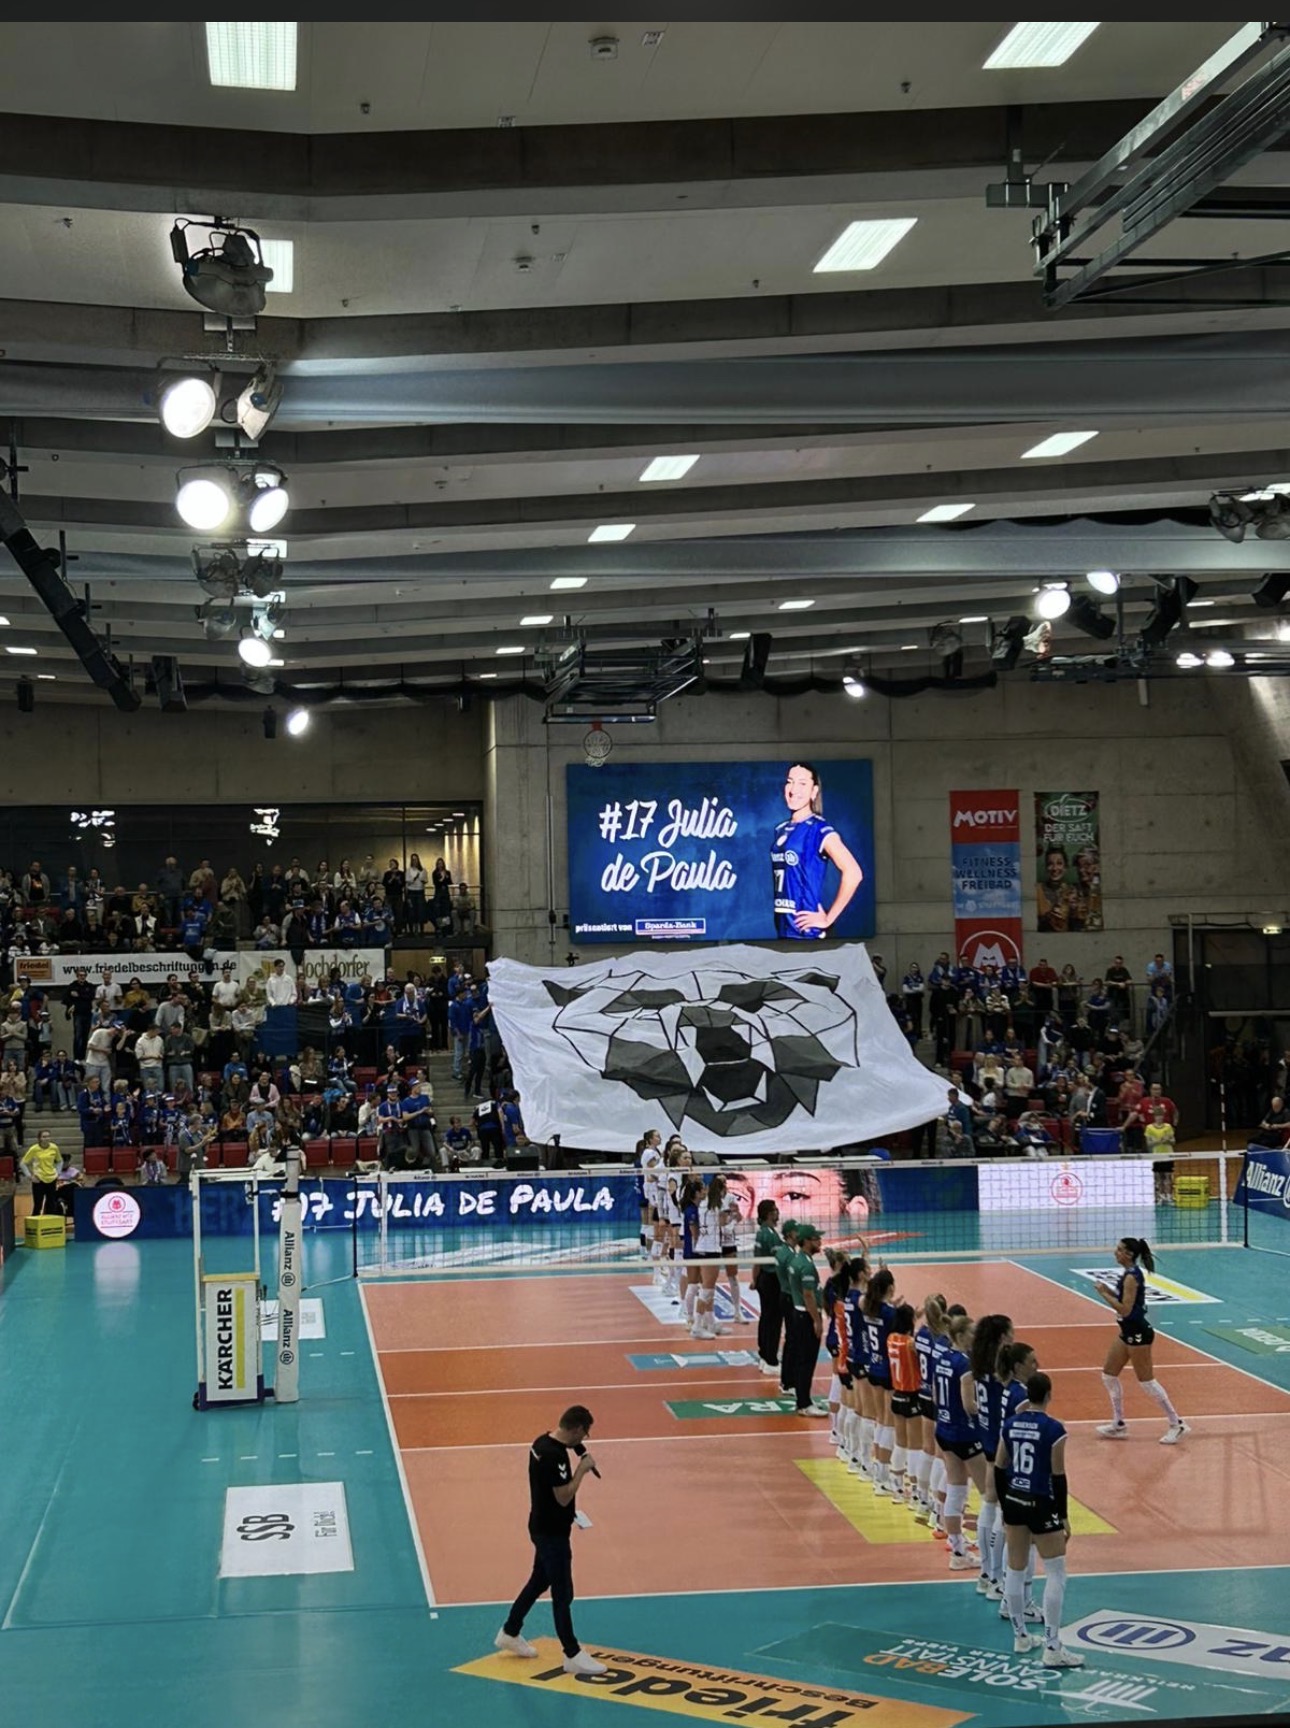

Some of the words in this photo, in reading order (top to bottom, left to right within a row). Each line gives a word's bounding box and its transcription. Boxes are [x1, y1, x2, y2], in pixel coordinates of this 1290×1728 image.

[599, 799, 658, 843] #17
[658, 797, 738, 848] Julia
[953, 810, 1018, 828] MOTIV
[601, 852, 640, 892] de
[640, 849, 737, 893] Paula
[956, 867, 1017, 879] WELLNESS
[961, 879, 1013, 891] FREIBAD
[62, 958, 237, 975] www.friedelbeschriftungn.de
[302, 953, 370, 979] ochdorfer
[1241, 1161, 1286, 1197] Allianz
[344, 1190, 445, 1219] JULIA
[459, 1190, 498, 1215] DE
[510, 1184, 615, 1215] PAULA
[284, 1231, 295, 1270] Allianz
[216, 1288, 233, 1390] KÄRCHER
[283, 1309, 294, 1348] Allianz
[868, 1325, 880, 1351] 5
[919, 1353, 928, 1380] 8
[1012, 1441, 1035, 1475] 16
[590, 1651, 878, 1710] Beschriftungen
[863, 1653, 1047, 1691] SOLEBAD
[879, 1644, 1063, 1681] CANNSTATT
[530, 1665, 855, 1728] friedel
